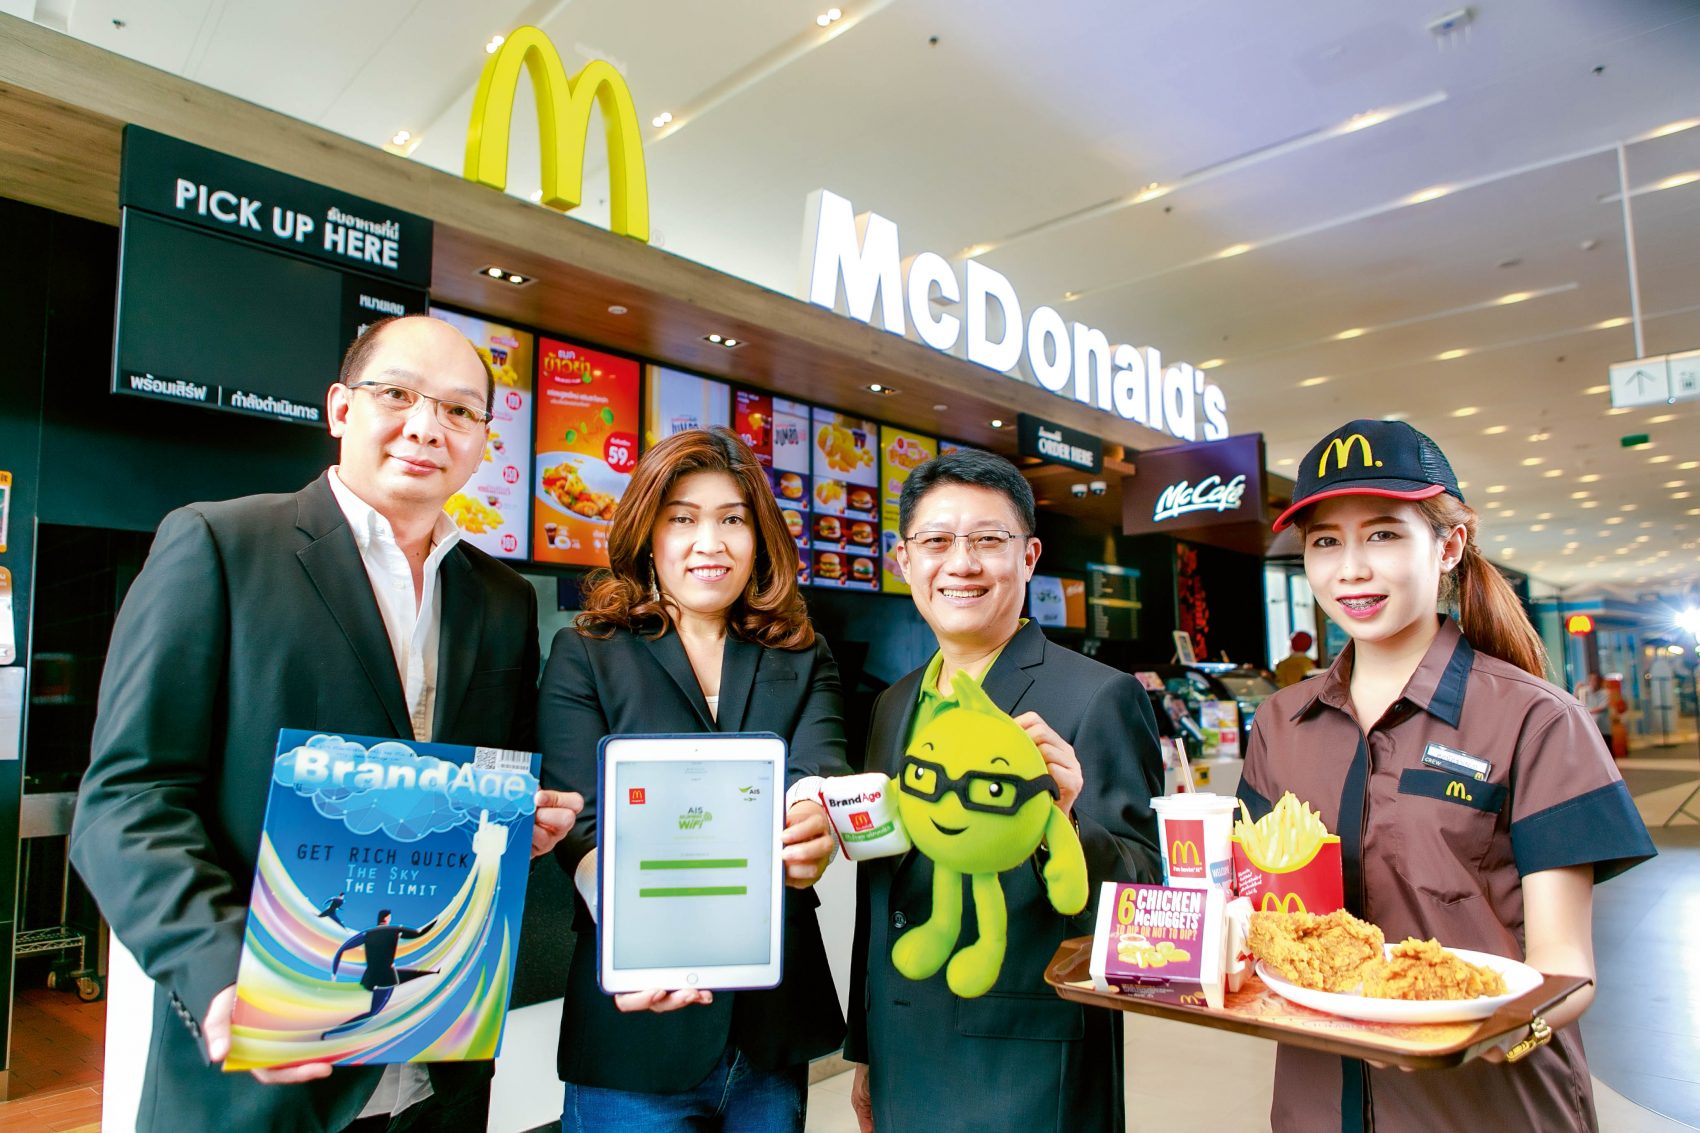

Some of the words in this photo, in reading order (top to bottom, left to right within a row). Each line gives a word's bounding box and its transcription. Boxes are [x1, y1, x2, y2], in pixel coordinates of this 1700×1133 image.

[175, 177, 262, 232] PICK
[272, 205, 315, 243] UP
[324, 222, 399, 270] HERE
[807, 188, 1229, 442] McDonald's
[688, 806, 703, 814] AIS
[828, 791, 882, 808] BrandAge
[297, 844, 334, 861] GET
[349, 847, 397, 865] RICH
[411, 850, 469, 869] QUICK
[1117, 887, 1137, 926] 6
[1136, 888, 1202, 914] CHICKEN
